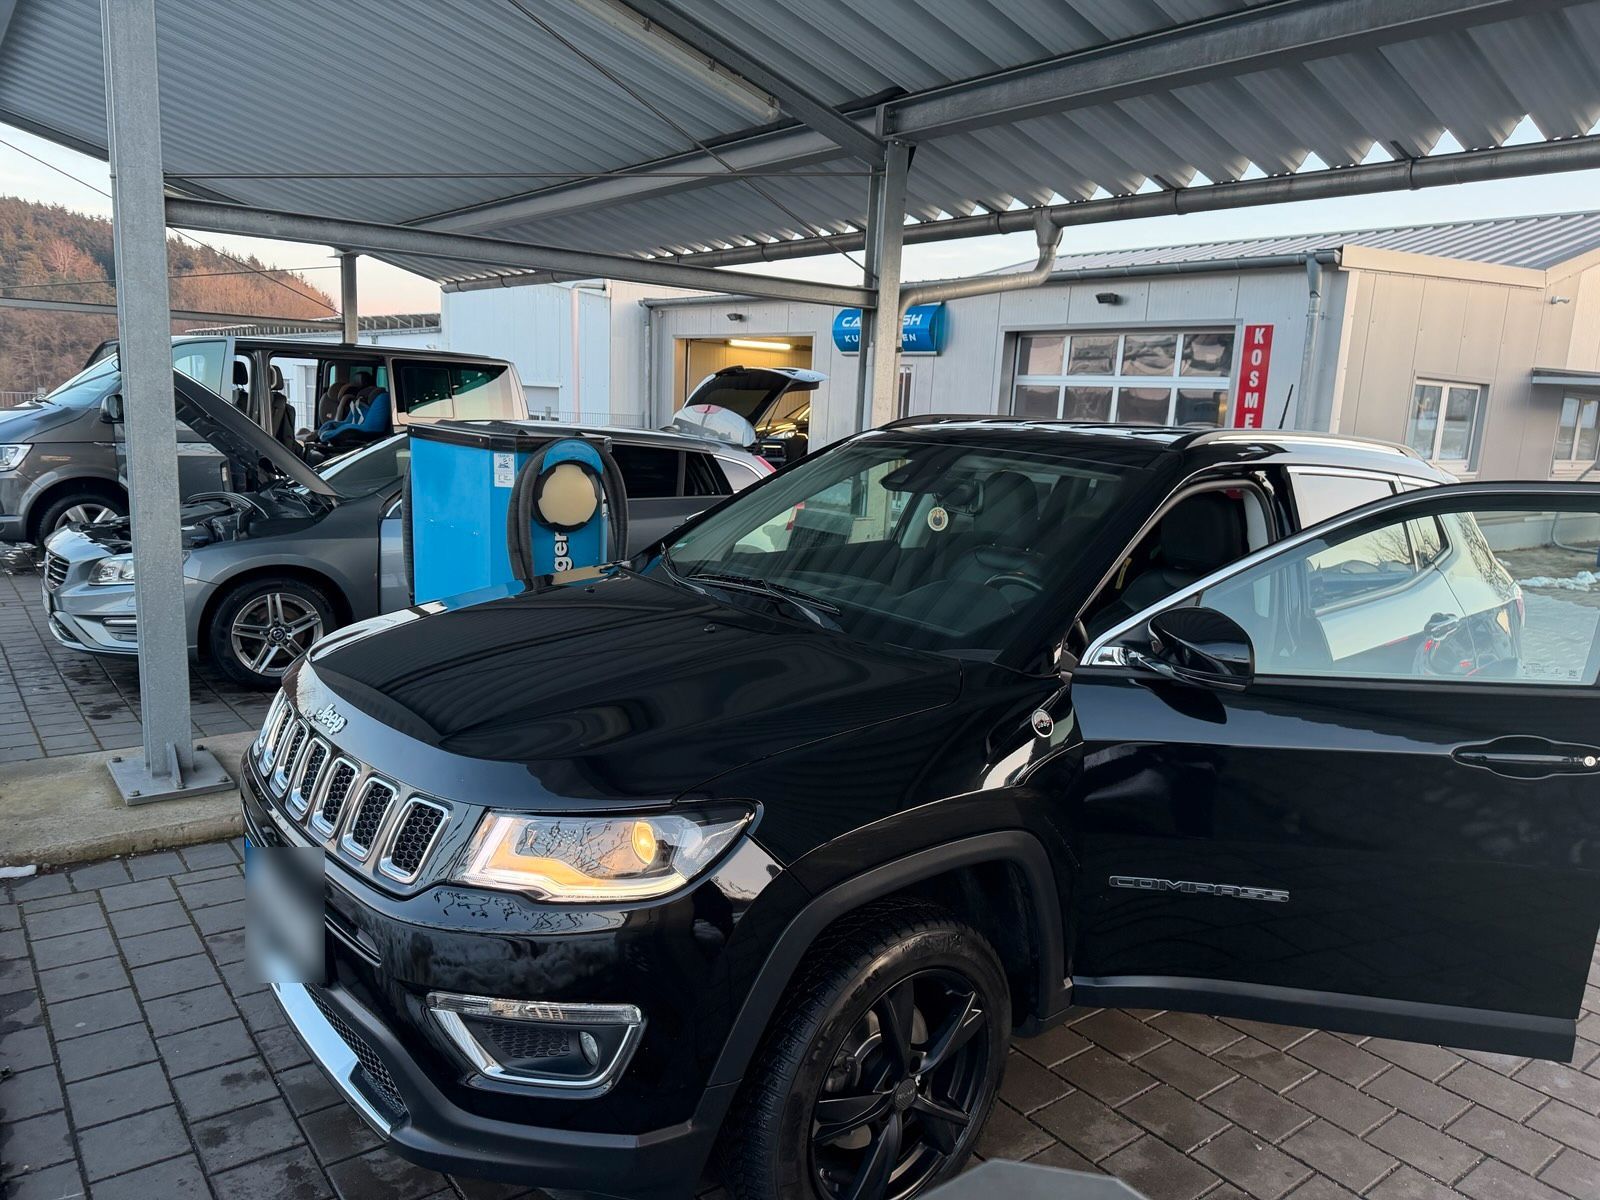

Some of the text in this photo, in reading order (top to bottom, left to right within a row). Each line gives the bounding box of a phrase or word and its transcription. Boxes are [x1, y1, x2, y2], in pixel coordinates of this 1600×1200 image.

[842, 314, 922, 328] CA SH
[1244, 327, 1265, 429] KOSME
[554, 531, 574, 572] ger
[315, 703, 346, 734] Jeep
[1108, 875, 1290, 903] COMPASS
